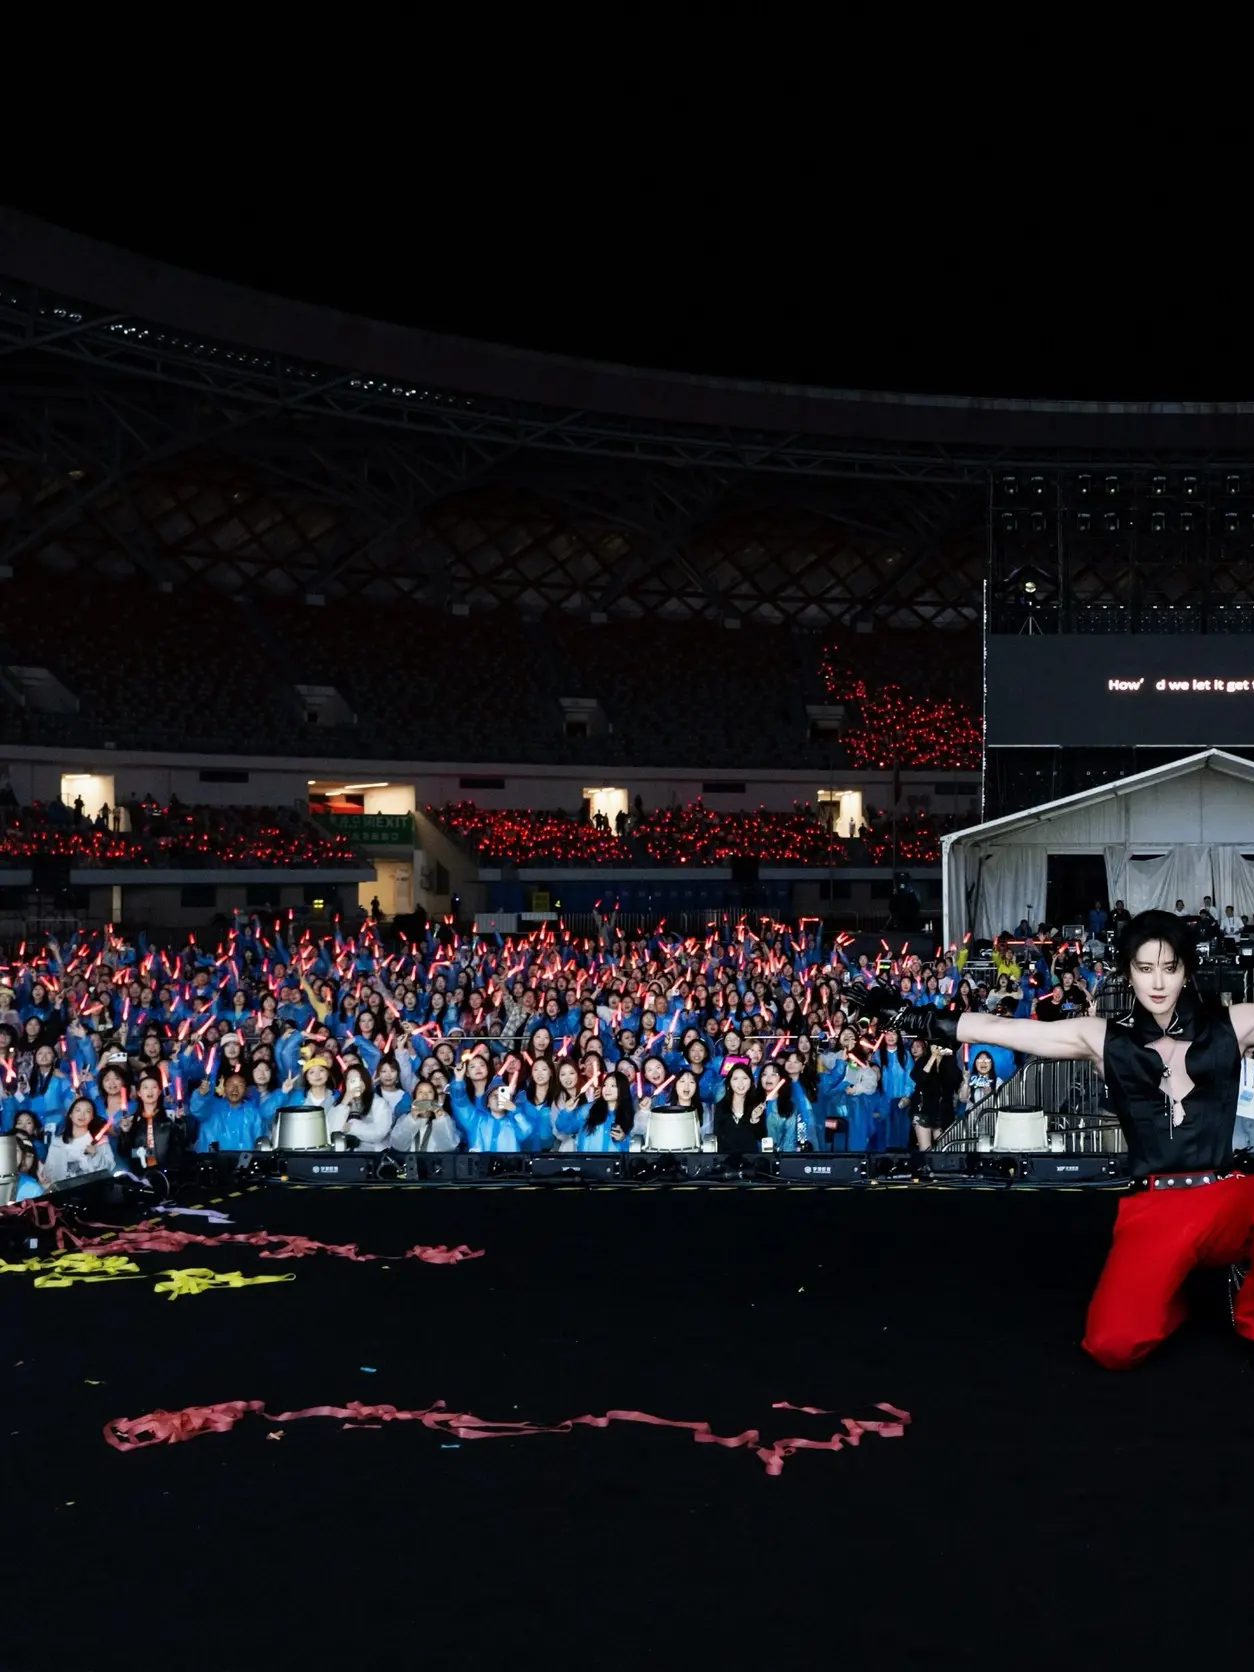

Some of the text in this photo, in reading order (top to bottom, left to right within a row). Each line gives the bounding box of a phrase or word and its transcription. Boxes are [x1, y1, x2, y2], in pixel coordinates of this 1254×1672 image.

[1155, 678, 1166, 690] d
[1167, 680, 1190, 690] we
[1191, 678, 1211, 690] let
[1213, 678, 1224, 690] it
[1225, 679, 1250, 692] get
[376, 816, 408, 828] EXIT
